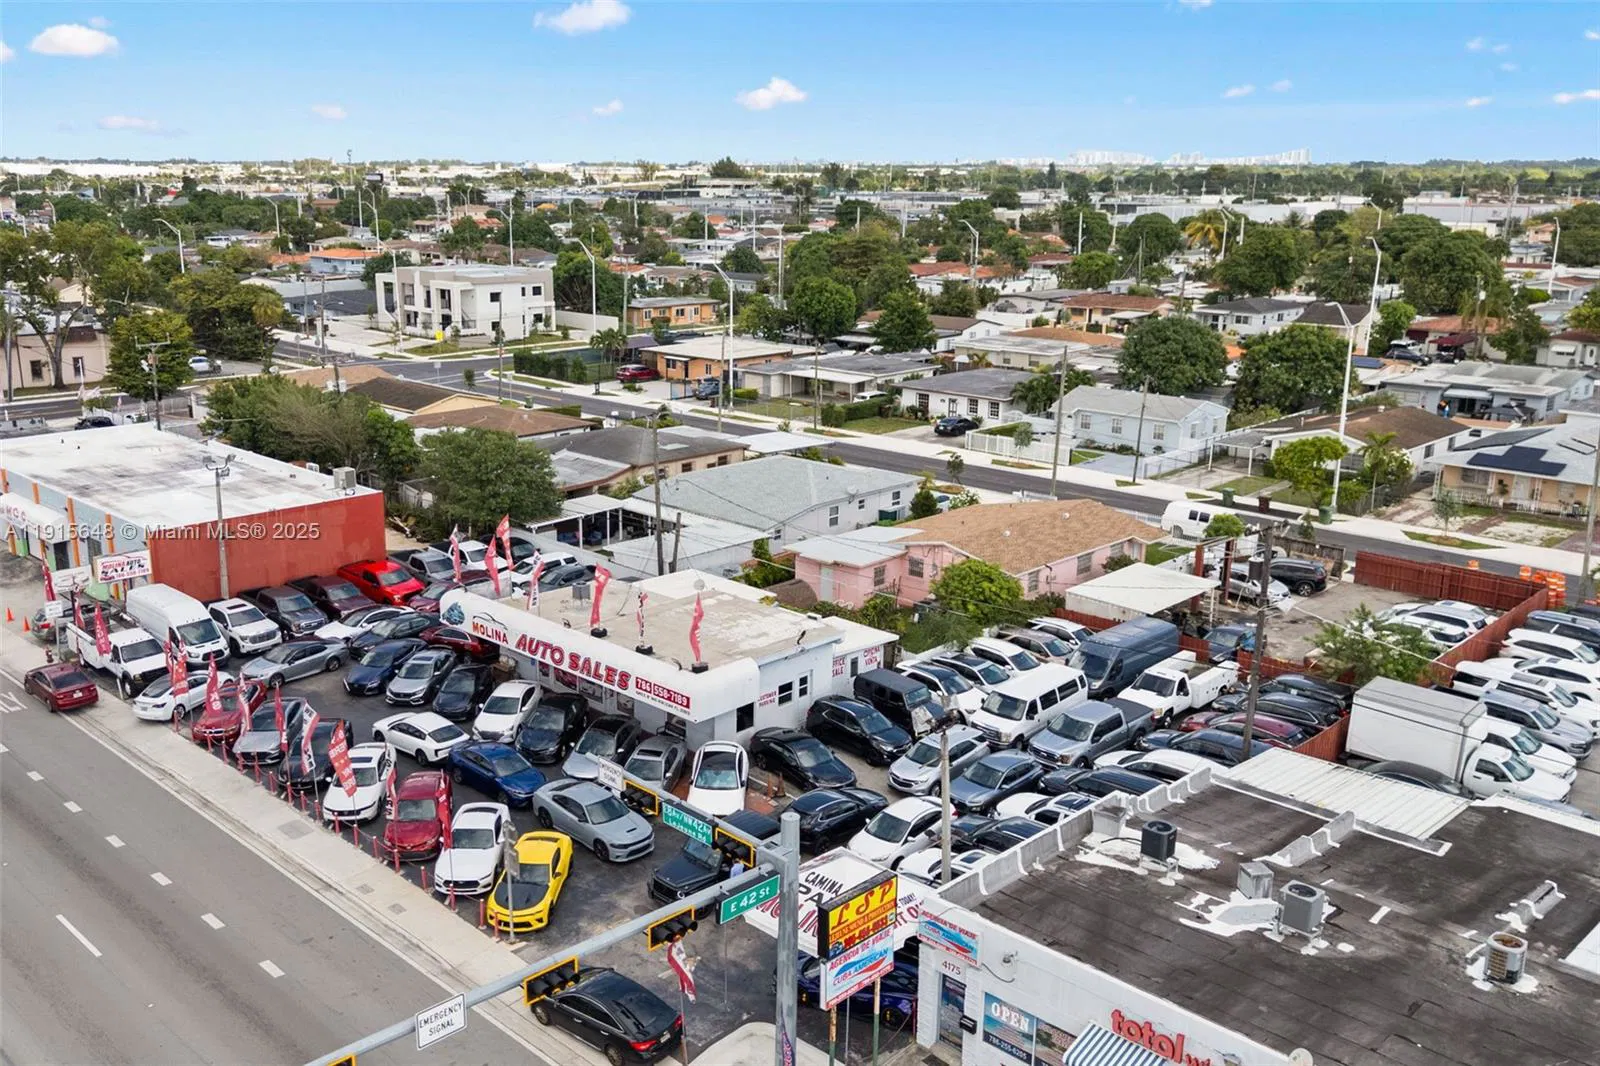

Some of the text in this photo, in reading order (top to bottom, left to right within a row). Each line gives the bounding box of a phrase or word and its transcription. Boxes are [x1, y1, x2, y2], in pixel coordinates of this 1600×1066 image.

[471, 621, 632, 690] MOLINA AUTO SALES
[637, 678, 650, 692] 786
[805, 871, 844, 897] CAMINA
[731, 886, 770, 913] E 42 St
[861, 940, 871, 953] DE
[942, 961, 961, 975] 4175
[420, 1002, 462, 1029] EMERGENCY
[428, 1018, 454, 1036] SIGNAL
[991, 1002, 1029, 1032] OPEN
[1111, 1008, 1185, 1063] total
